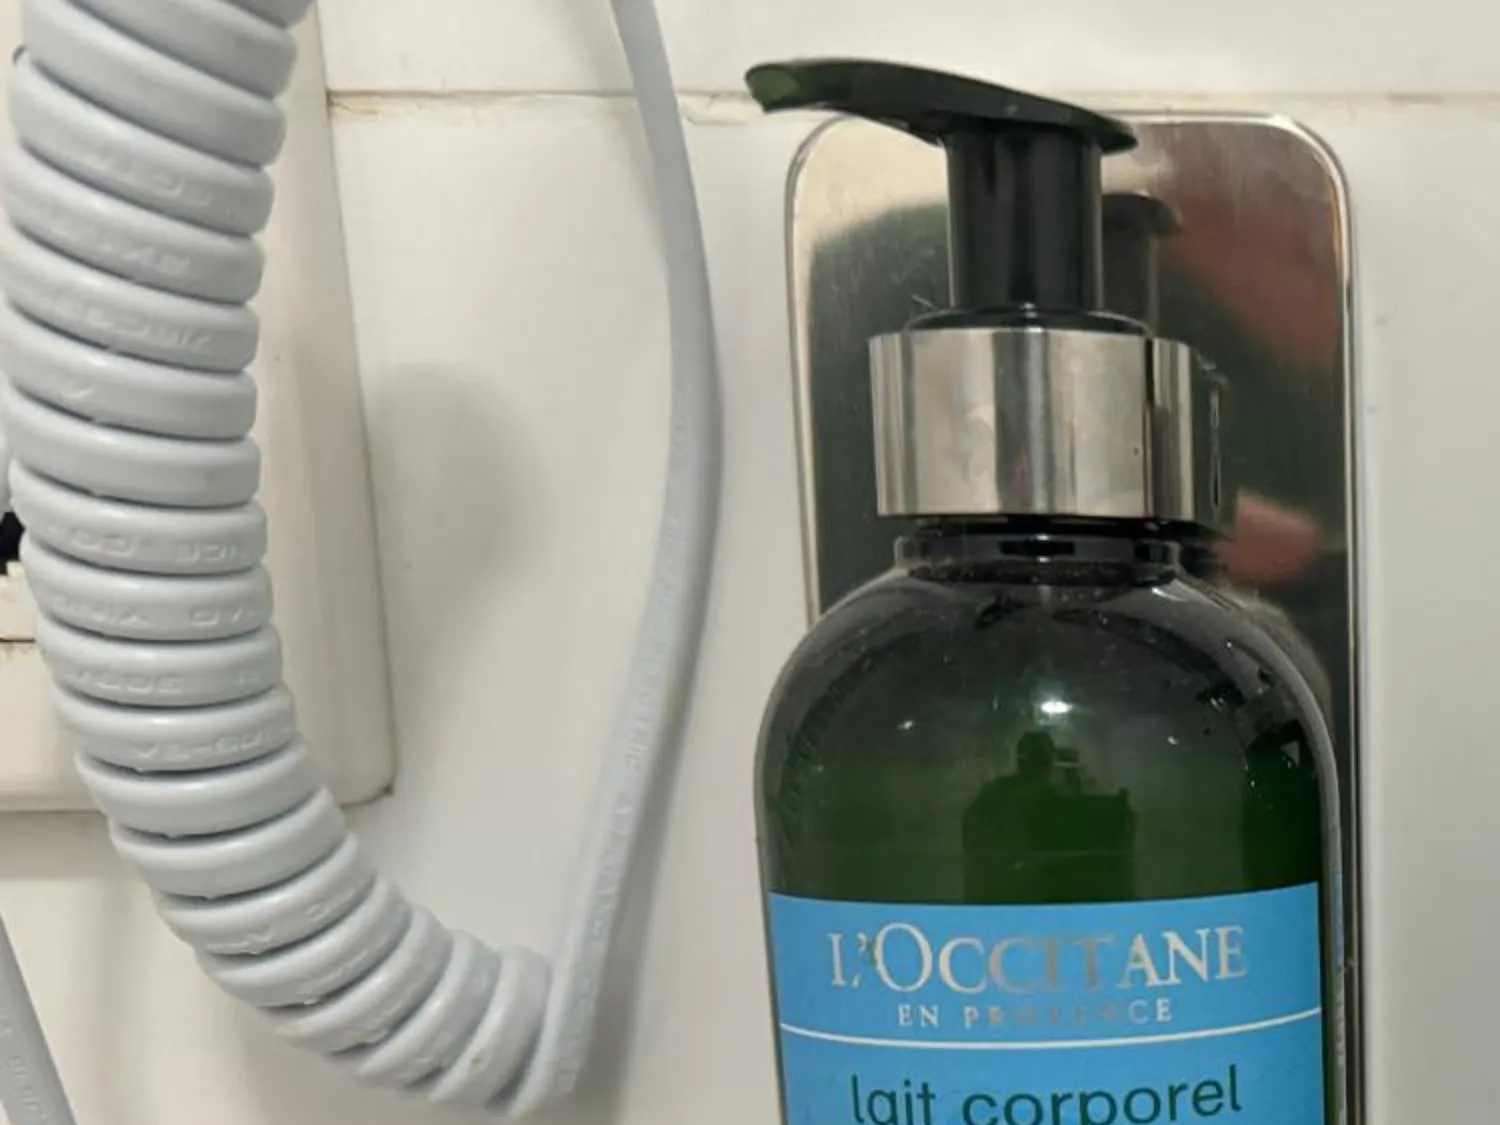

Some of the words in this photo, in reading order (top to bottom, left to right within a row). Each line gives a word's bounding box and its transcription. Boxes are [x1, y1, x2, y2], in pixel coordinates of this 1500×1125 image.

[829, 921, 1249, 993] L'OCCITANE
[898, 1003, 939, 1028] EN
[964, 998, 1174, 1029] PROVENCE
